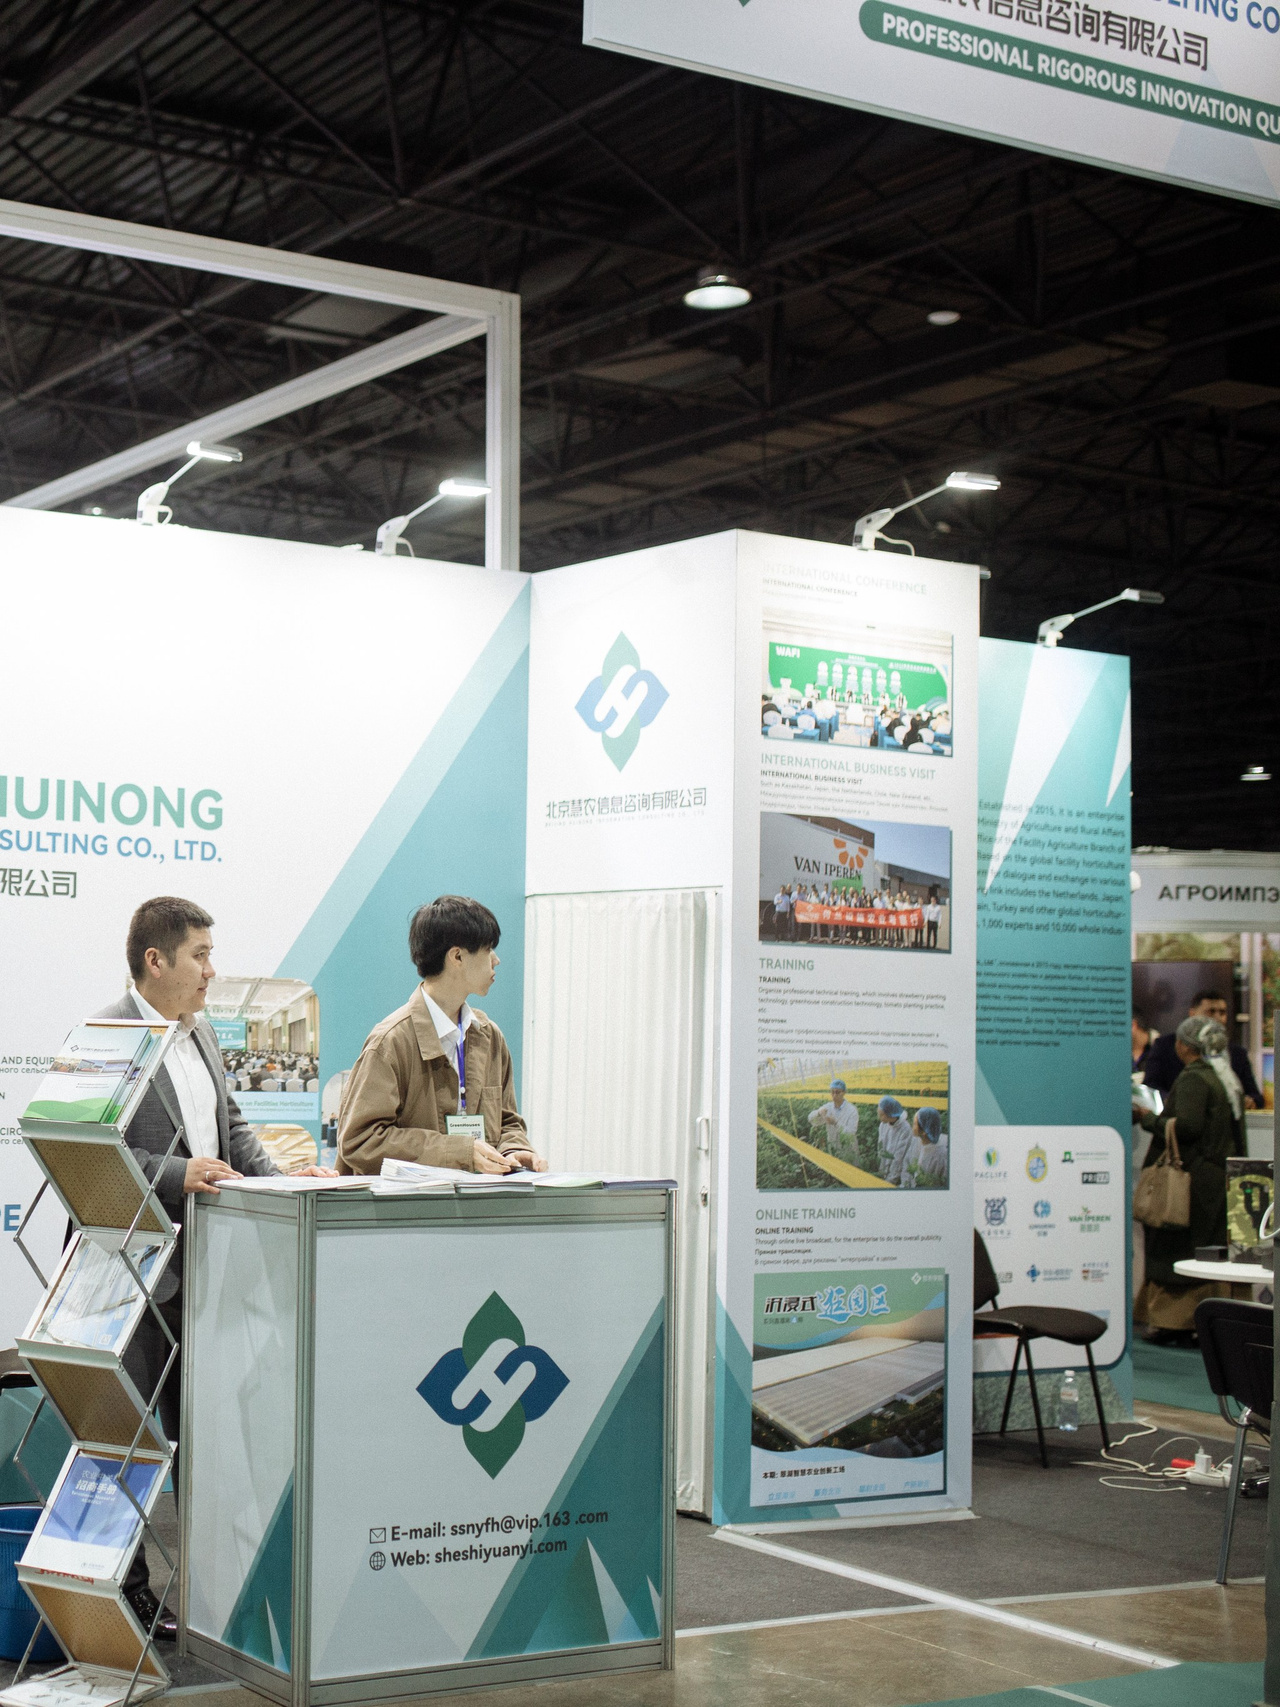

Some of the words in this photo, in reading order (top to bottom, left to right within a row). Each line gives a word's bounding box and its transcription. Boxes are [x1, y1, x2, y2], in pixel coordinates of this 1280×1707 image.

[883, 12, 1033, 72] PROFESSIONAL
[1037, 53, 1137, 98] RIGOROUS
[1141, 80, 1251, 127] INNOVATION
[760, 769, 812, 780] INTERNATIONAL
[815, 775, 845, 784] BUSINESS
[761, 753, 851, 772] INTERNATIONAL
[854, 762, 907, 777] BUSINESS
[909, 767, 936, 780] VISIT
[546, 787, 707, 819] 北京慧农信息咨询有限公司
[116, 836, 165, 864] CO.,
[174, 839, 223, 863] LTD.
[794, 856, 820, 875] VAN
[825, 863, 862, 880] IPEREN
[1159, 884, 1280, 903] АГРОИМПЭ
[759, 958, 815, 971] TRAINING
[759, 976, 791, 984] TRAINING
[1, 1056, 23, 1065] AND
[756, 1208, 799, 1221] ONLINE
[801, 1207, 856, 1220] TRAINING
[755, 1227, 780, 1235] ONLINE
[782, 1226, 814, 1235] TRAINING
[391, 1522, 446, 1541] E-mail:
[450, 1510, 570, 1538] ssnyfh@vip.163
[575, 1510, 608, 1525] .com
[391, 1550, 430, 1567] Web:
[434, 1539, 567, 1563] sheshiyuanyi.com
